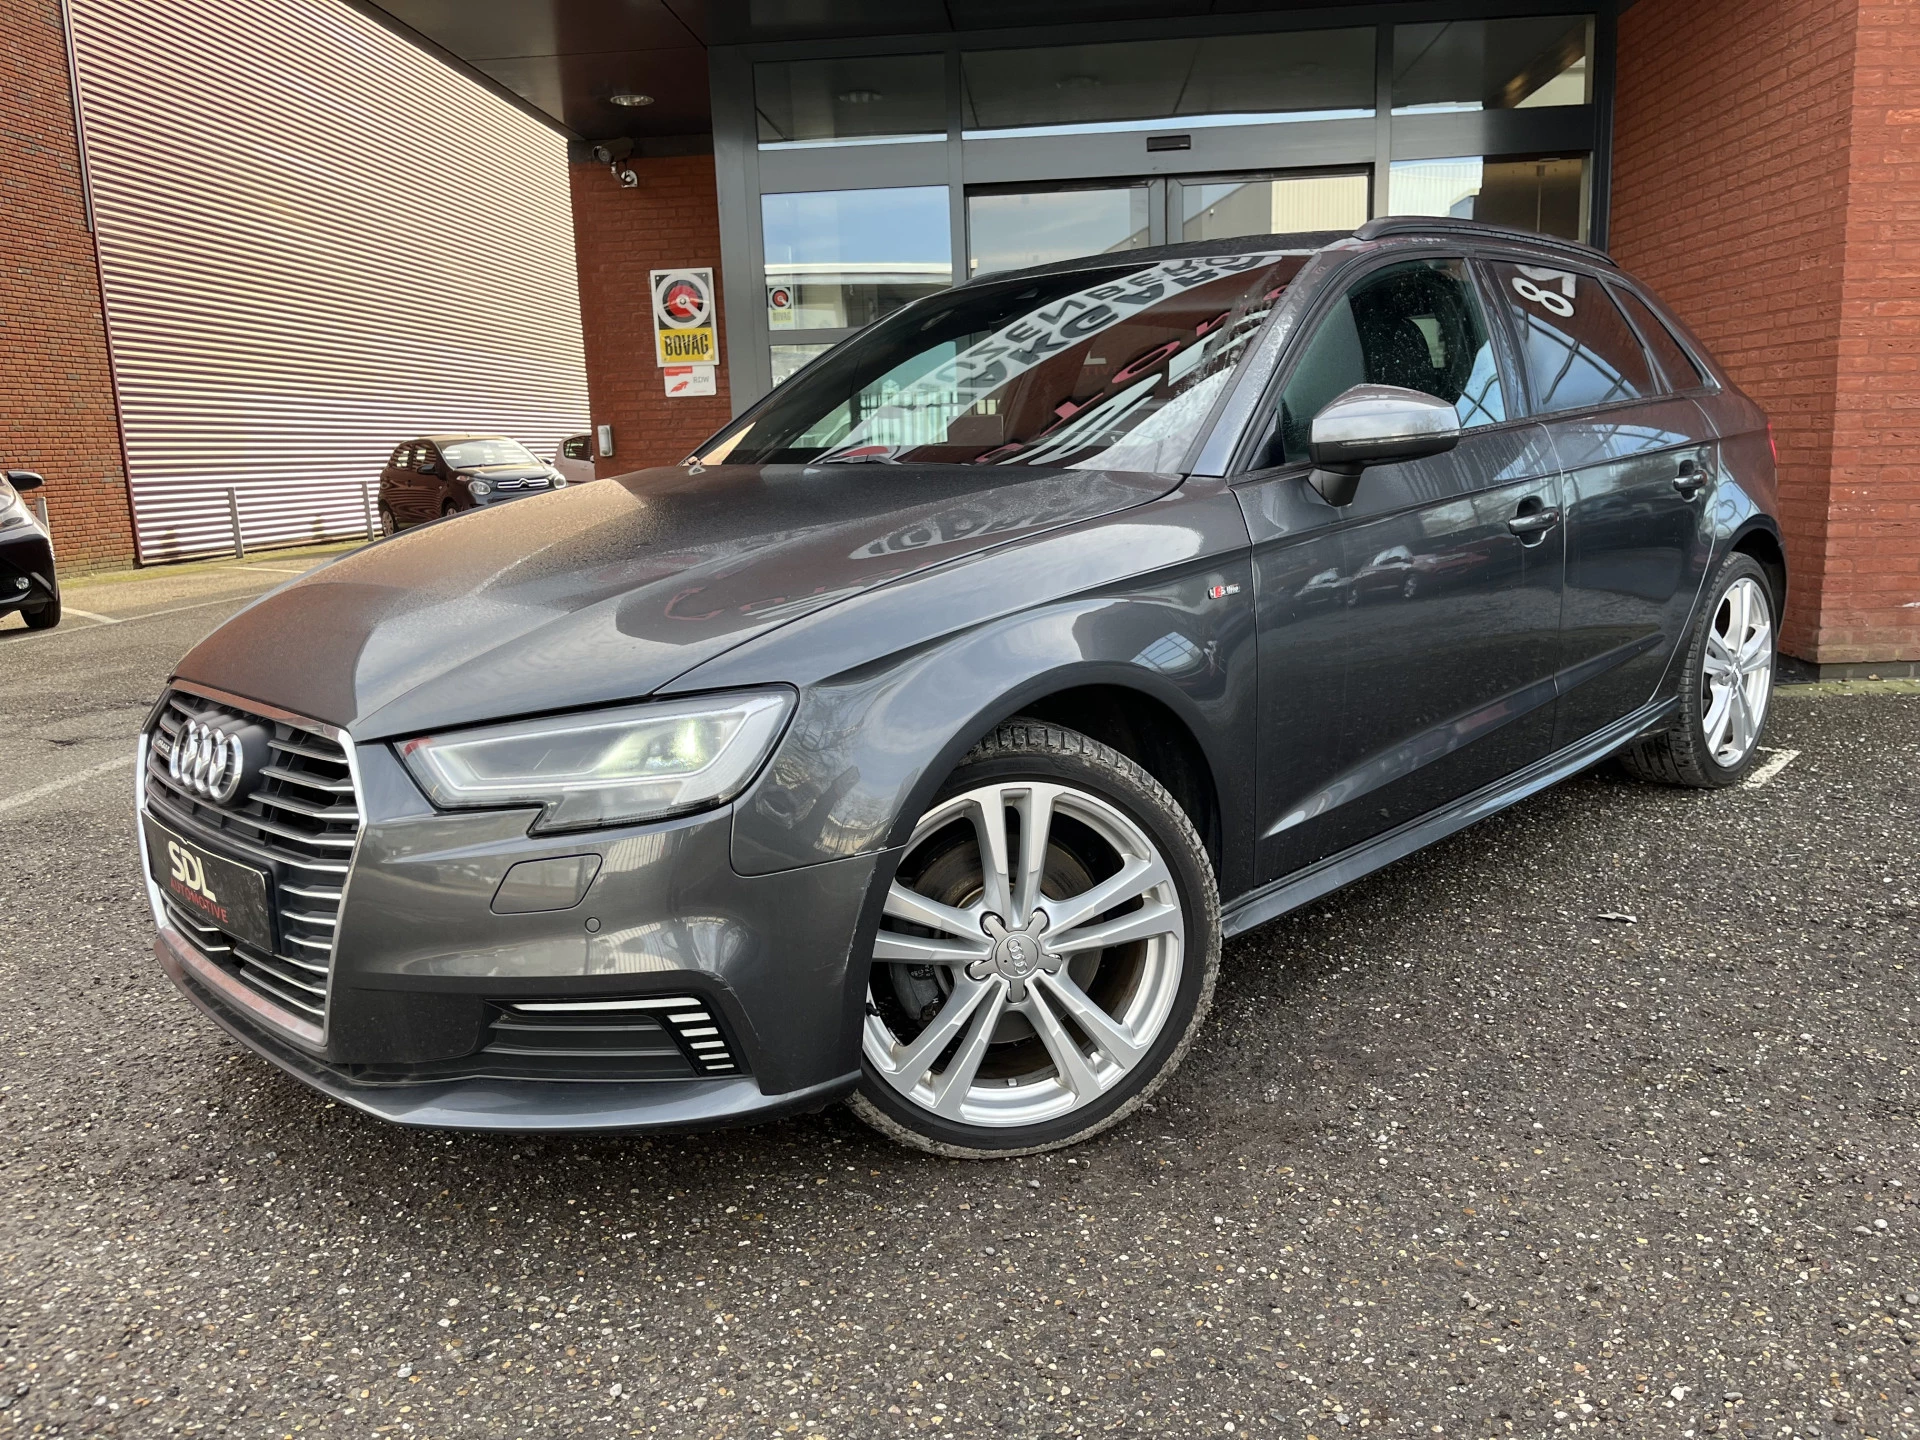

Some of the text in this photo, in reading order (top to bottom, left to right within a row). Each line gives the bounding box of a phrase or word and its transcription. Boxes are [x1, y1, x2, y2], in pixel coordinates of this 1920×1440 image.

[664, 333, 709, 356] BOVAG
[168, 841, 217, 903] SDL
[170, 877, 229, 924] AUTOMOTIVE
